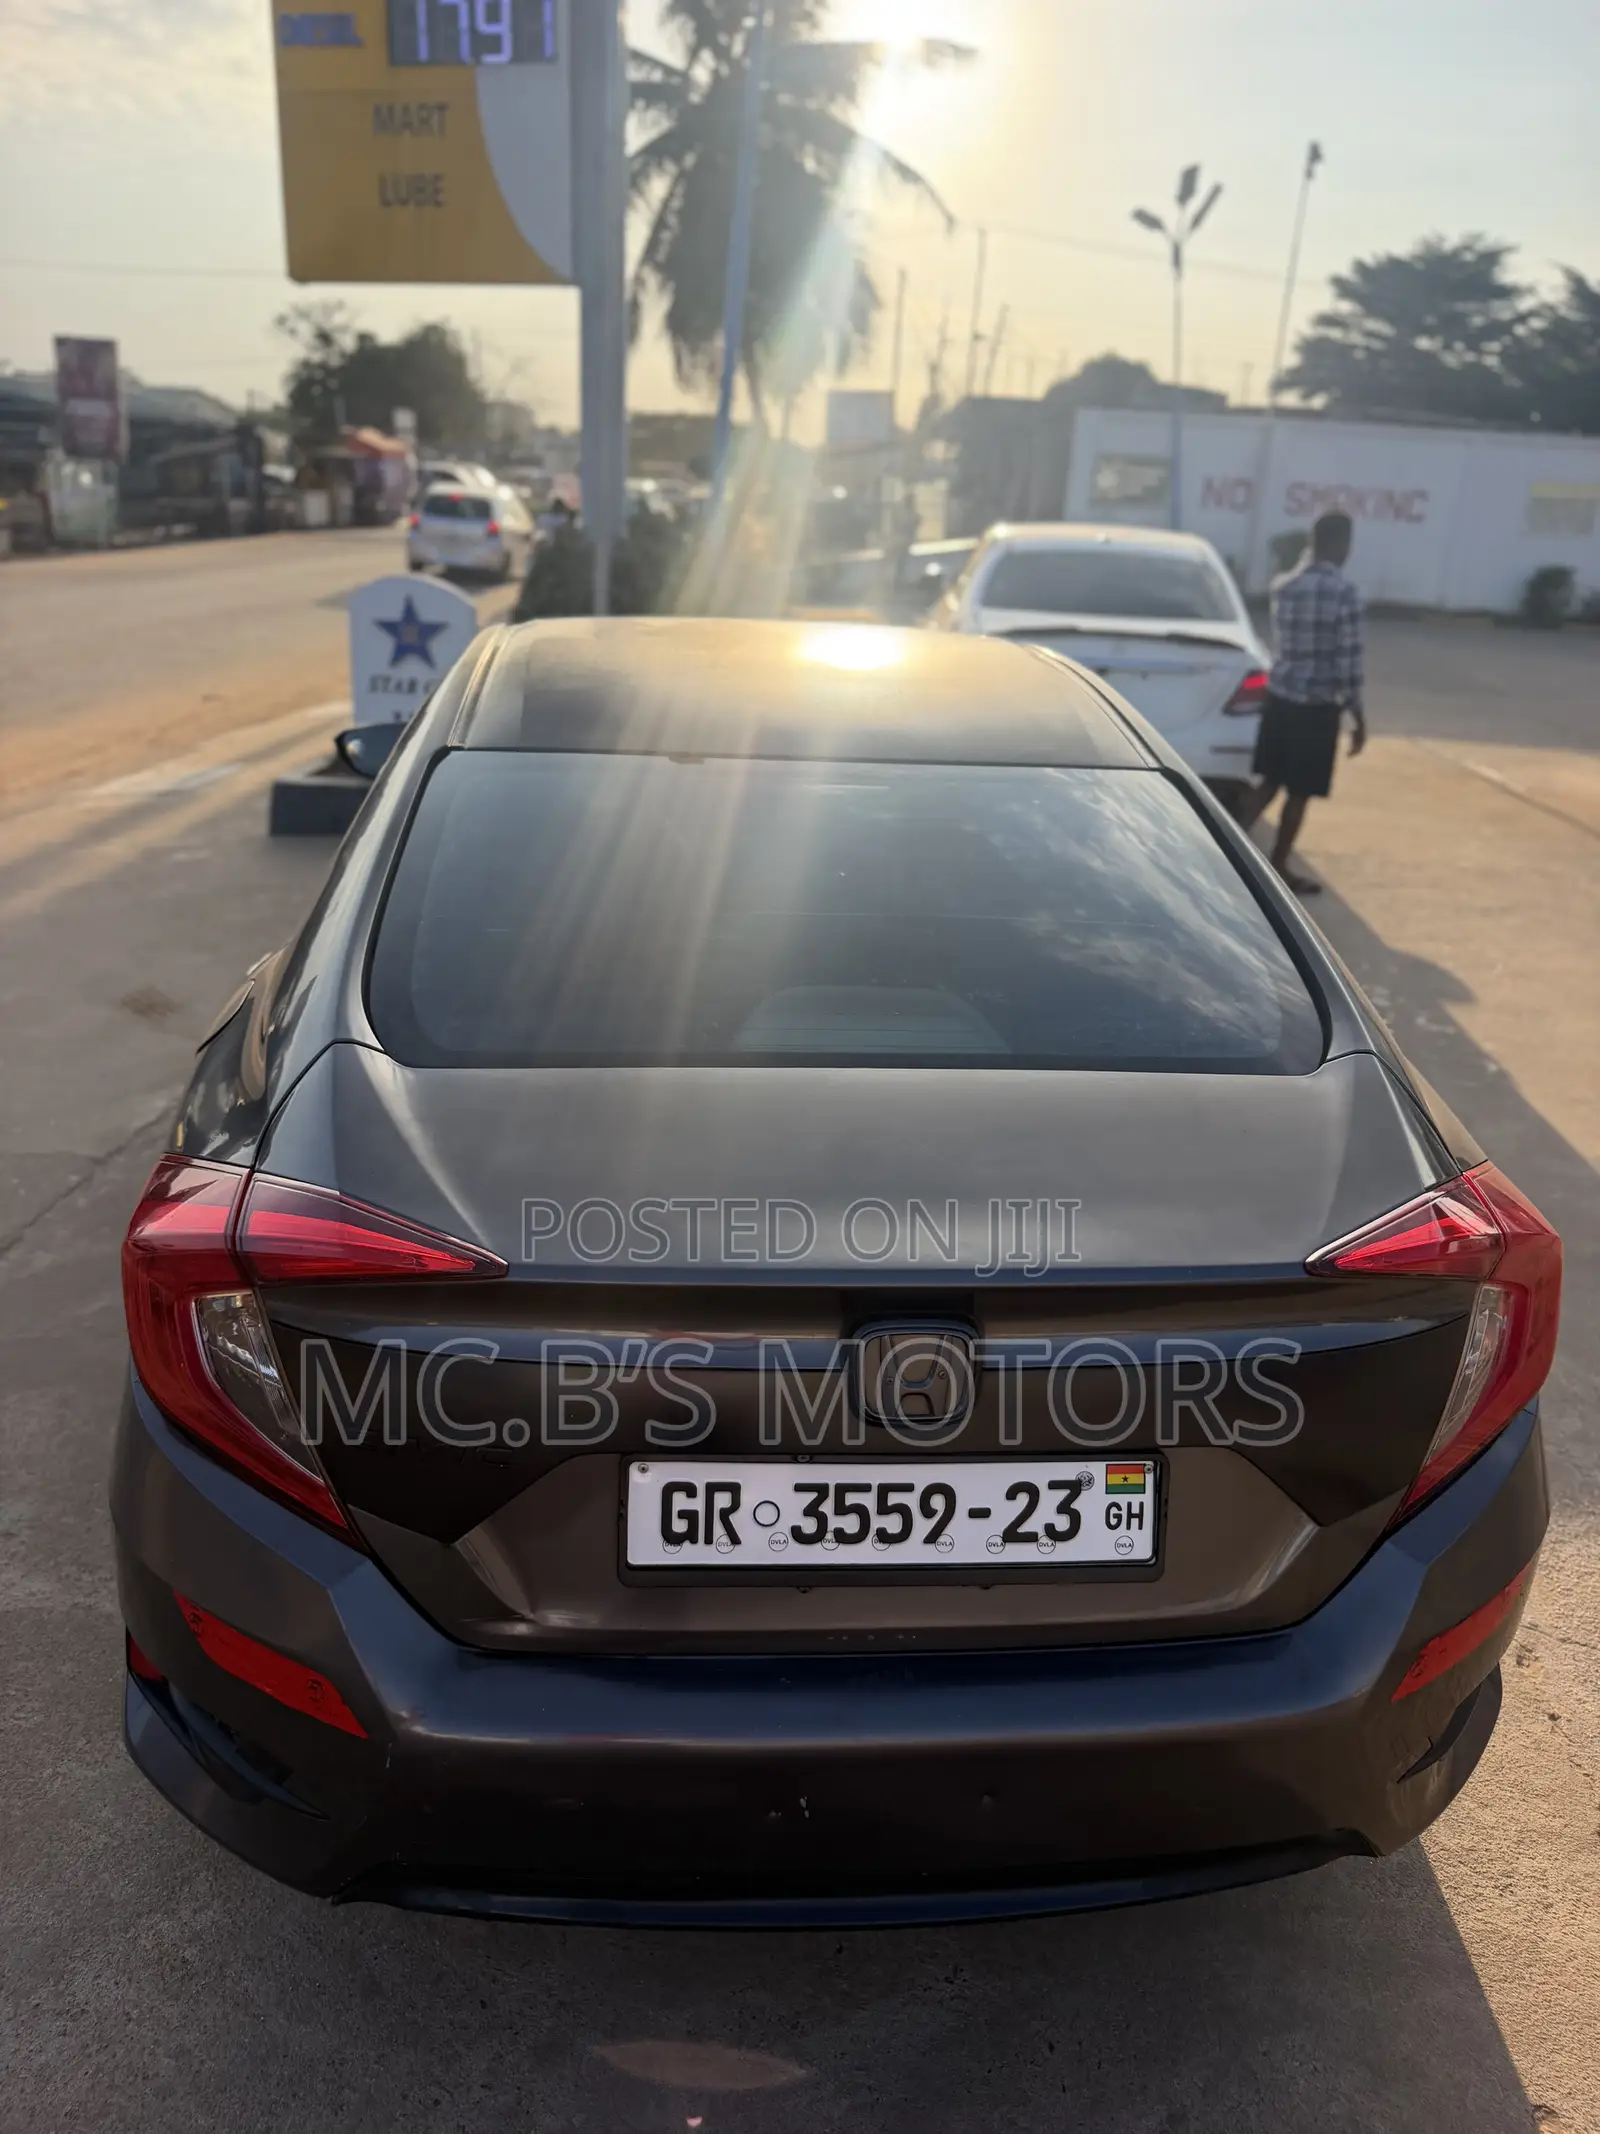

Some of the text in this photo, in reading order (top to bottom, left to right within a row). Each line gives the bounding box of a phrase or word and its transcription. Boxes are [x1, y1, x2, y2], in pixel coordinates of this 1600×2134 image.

[372, 103, 449, 136] MART
[378, 173, 446, 207] LUBE
[1201, 477, 1253, 513] NO
[660, 1481, 742, 1544] GR
[1105, 1501, 1144, 1531] GH
